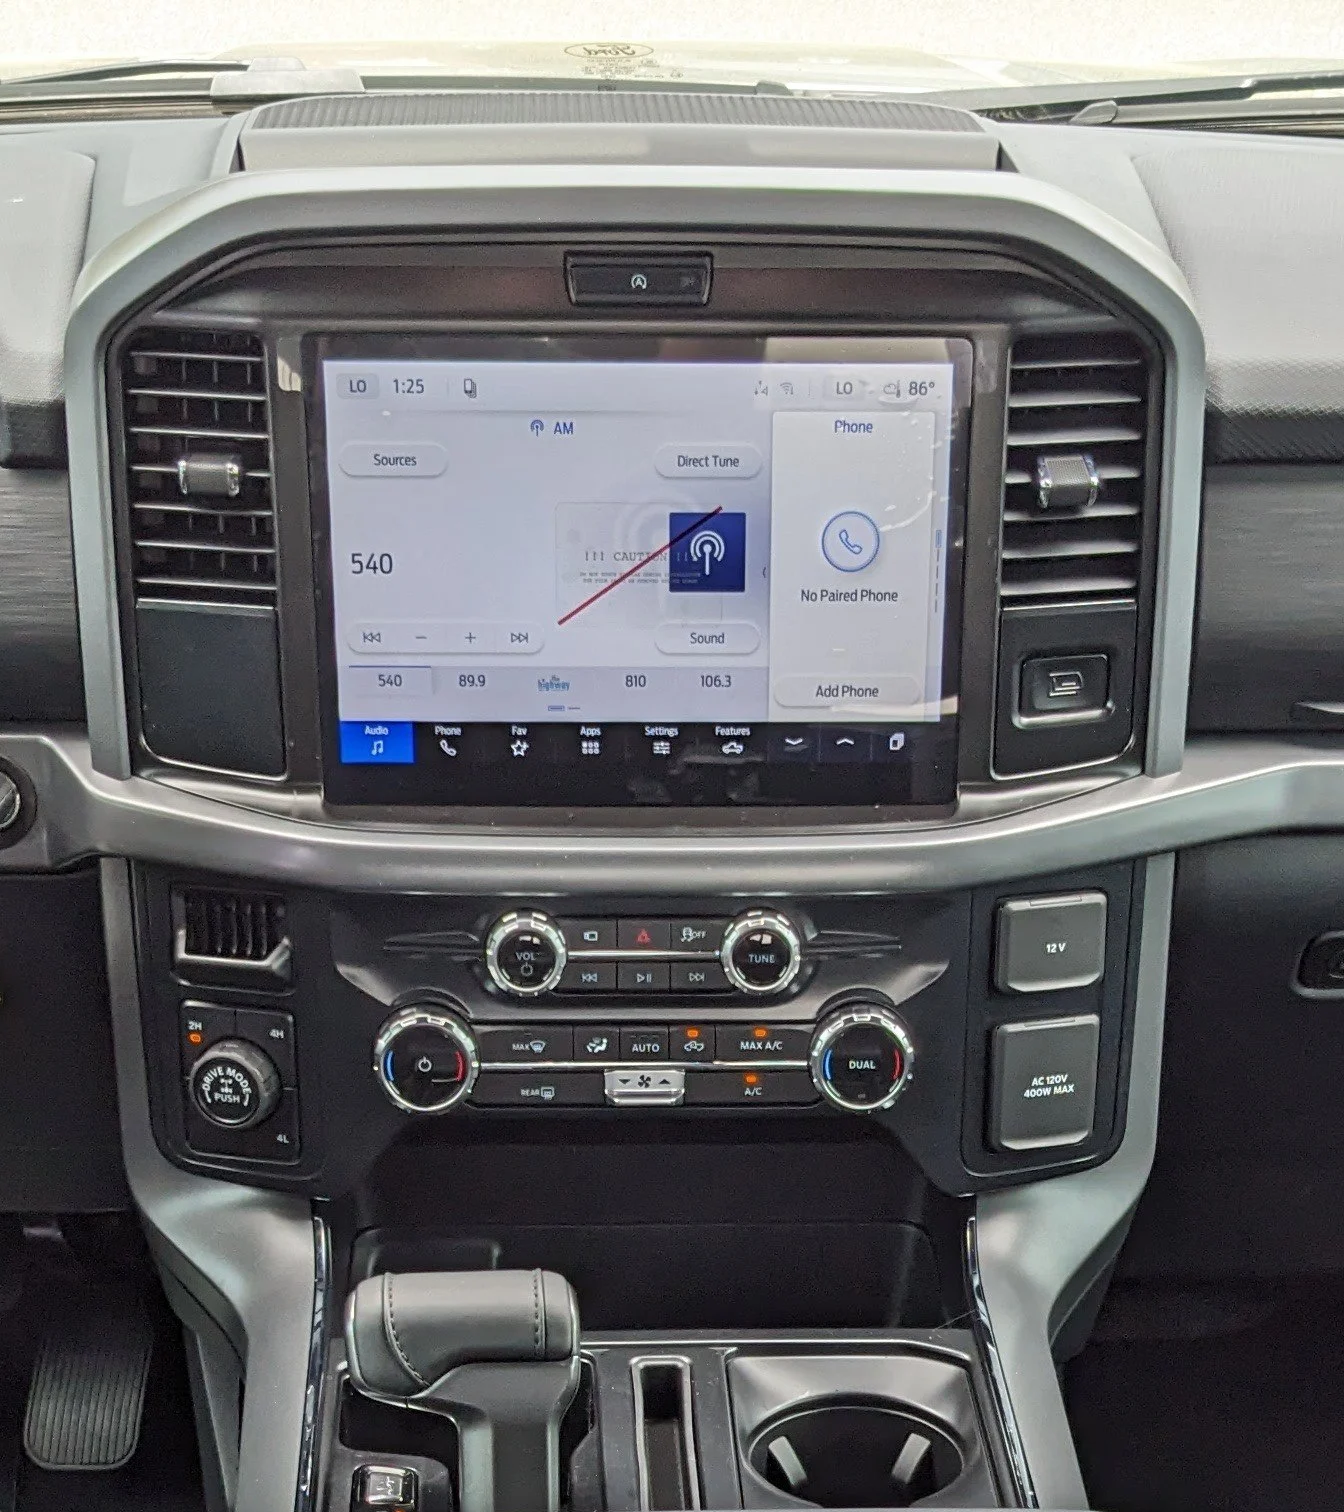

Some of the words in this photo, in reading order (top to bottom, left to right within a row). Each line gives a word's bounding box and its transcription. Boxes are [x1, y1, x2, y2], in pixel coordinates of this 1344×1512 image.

[349, 380, 367, 393] LO
[392, 378, 425, 394] 1:25
[836, 382, 853, 395] LO
[908, 381, 936, 396] 86°
[553, 421, 574, 435] AM
[834, 420, 873, 434] Phone
[373, 454, 417, 466] Sources
[677, 455, 709, 468] Direct
[712, 455, 740, 468] Tune
[613, 551, 668, 562] CAUTON
[350, 553, 394, 575] 540
[801, 589, 818, 602] No
[820, 589, 858, 602] Paired
[860, 589, 899, 602] Phone
[690, 632, 725, 645] Sound
[378, 674, 403, 687] 540
[459, 674, 486, 687] 89.9
[625, 675, 646, 688] 810
[700, 675, 732, 688] 106.3
[815, 685, 839, 698] Add
[841, 685, 879, 698] Phone
[364, 725, 389, 736] Audio
[434, 725, 462, 736] Phone
[511, 725, 527, 736] Fav
[580, 725, 601, 737] Apps
[644, 725, 678, 737] Settings
[714, 725, 750, 737] Features
[690, 930, 706, 939] OFF
[1046, 944, 1057, 953] 12
[1058, 943, 1066, 952] V
[516, 952, 536, 961] VOL
[748, 954, 775, 963] TUNE
[188, 1021, 203, 1031] 2H
[269, 1029, 284, 1039] 4H
[512, 1042, 530, 1051] MAX
[631, 1042, 660, 1053] AUTO
[740, 1041, 763, 1051] MAX
[765, 1040, 783, 1052] A/C
[848, 1059, 876, 1070] DUAL
[201, 1066, 224, 1092] DRIVE
[226, 1067, 252, 1094] MODE
[1031, 1076, 1044, 1087] AC
[1046, 1074, 1068, 1086] 120V
[521, 1088, 540, 1097] REAR
[744, 1086, 762, 1097] A/C
[1024, 1087, 1052, 1098] 400W
[1053, 1084, 1075, 1095] MAX
[214, 1092, 241, 1103] PUSH
[276, 1134, 290, 1144] 4L
